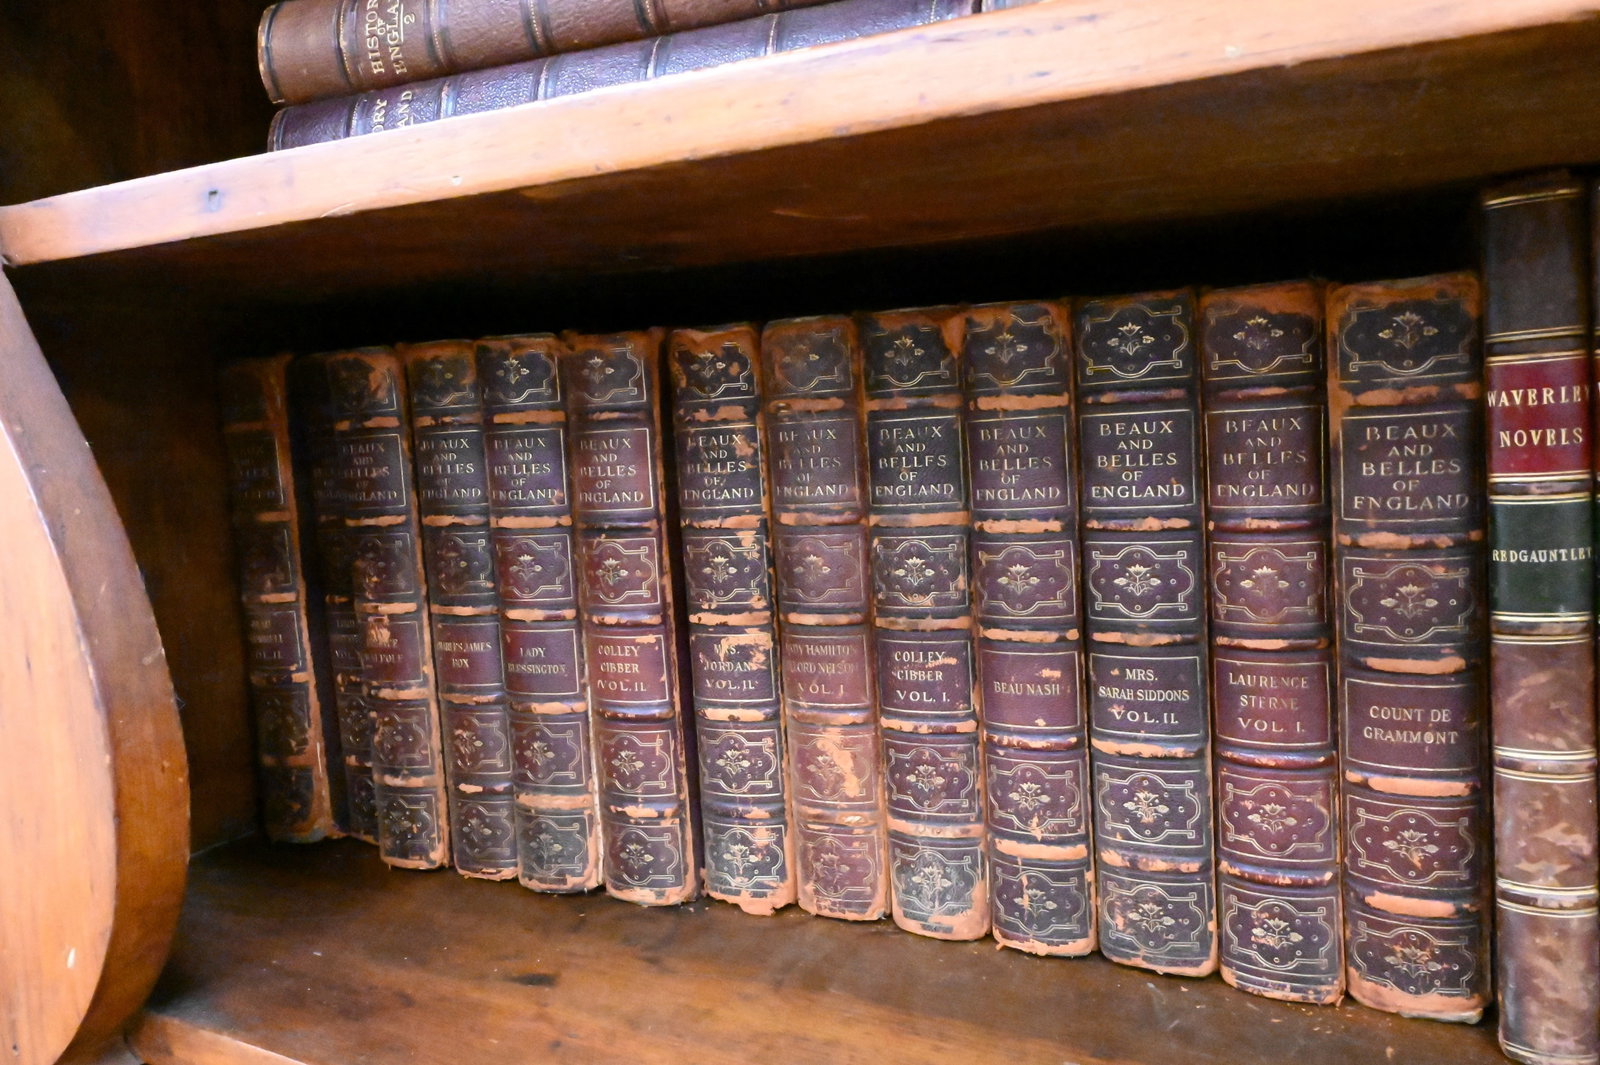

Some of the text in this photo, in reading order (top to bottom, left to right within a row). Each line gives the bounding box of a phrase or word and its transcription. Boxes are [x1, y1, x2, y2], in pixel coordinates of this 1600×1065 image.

[404, 13, 416, 24] 2
[377, 18, 386, 35] OF
[387, 0, 407, 75] ENGLA
[1100, 420, 1173, 436] BEAUX
[1226, 417, 1303, 433] BEAUX
[1366, 423, 1456, 440] BEAUX
[880, 426, 942, 440] BEAUX
[981, 425, 1047, 441] BEAUX
[1499, 427, 1584, 447] NOVELS
[494, 437, 546, 449] BEAUX
[580, 438, 631, 450] BEAUX
[895, 442, 926, 453] AND
[996, 443, 1029, 454] AND
[1117, 439, 1153, 450] AND
[1245, 437, 1281, 447] AND
[703, 449, 728, 459] AND
[793, 445, 821, 454] AND
[1388, 444, 1433, 457] AND
[433, 452, 457, 461] AND
[509, 452, 532, 461] AND
[592, 453, 618, 462] AND
[879, 454, 947, 469] BELLES
[980, 456, 1052, 470] BELLES
[1097, 452, 1177, 468] BELLES
[1223, 450, 1306, 466] BELLES
[580, 464, 637, 477] BELLES
[687, 461, 747, 473] BELLES
[1362, 458, 1461, 476] BELLES
[797, 472, 812, 483] OF
[899, 471, 918, 481] OF
[1001, 474, 1020, 485] OF
[1122, 470, 1143, 481] OF
[1248, 469, 1271, 480] OF
[511, 478, 527, 487] OF
[596, 479, 611, 489] OF
[704, 476, 721, 487] OF
[1392, 479, 1420, 491] OF
[492, 489, 557, 501] ENGLAND
[684, 487, 754, 500] ENGLAND
[777, 483, 849, 497] ENGLAND
[875, 483, 954, 497] ENGLAND
[976, 486, 1060, 501] ENGLAND
[1091, 484, 1185, 498] ENGLAND
[1217, 483, 1315, 497] ENGLAND
[579, 491, 644, 503] ENGLAND
[1354, 493, 1469, 510] ENGLAND
[1492, 547, 1592, 562] REDGAUNTLET
[519, 647, 546, 658] LADY
[598, 645, 640, 656] COLLEY
[894, 651, 945, 663] COLLEY
[600, 662, 639, 673] CIBBER
[704, 661, 751, 672] JORDAN
[897, 670, 943, 681] CIBBER
[1125, 668, 1158, 681] MRS.
[1229, 672, 1309, 689] LAURENCE
[993, 681, 1060, 695] BEAU NASH
[1098, 685, 1190, 702] SARAH SIDDONS
[896, 690, 936, 702] VOL.
[1240, 694, 1300, 710] STERNE
[1111, 709, 1159, 723] VOL.
[1369, 705, 1452, 722] COUNT DE
[1237, 717, 1287, 732] VOL.
[1363, 726, 1458, 744] GRAMMONT
